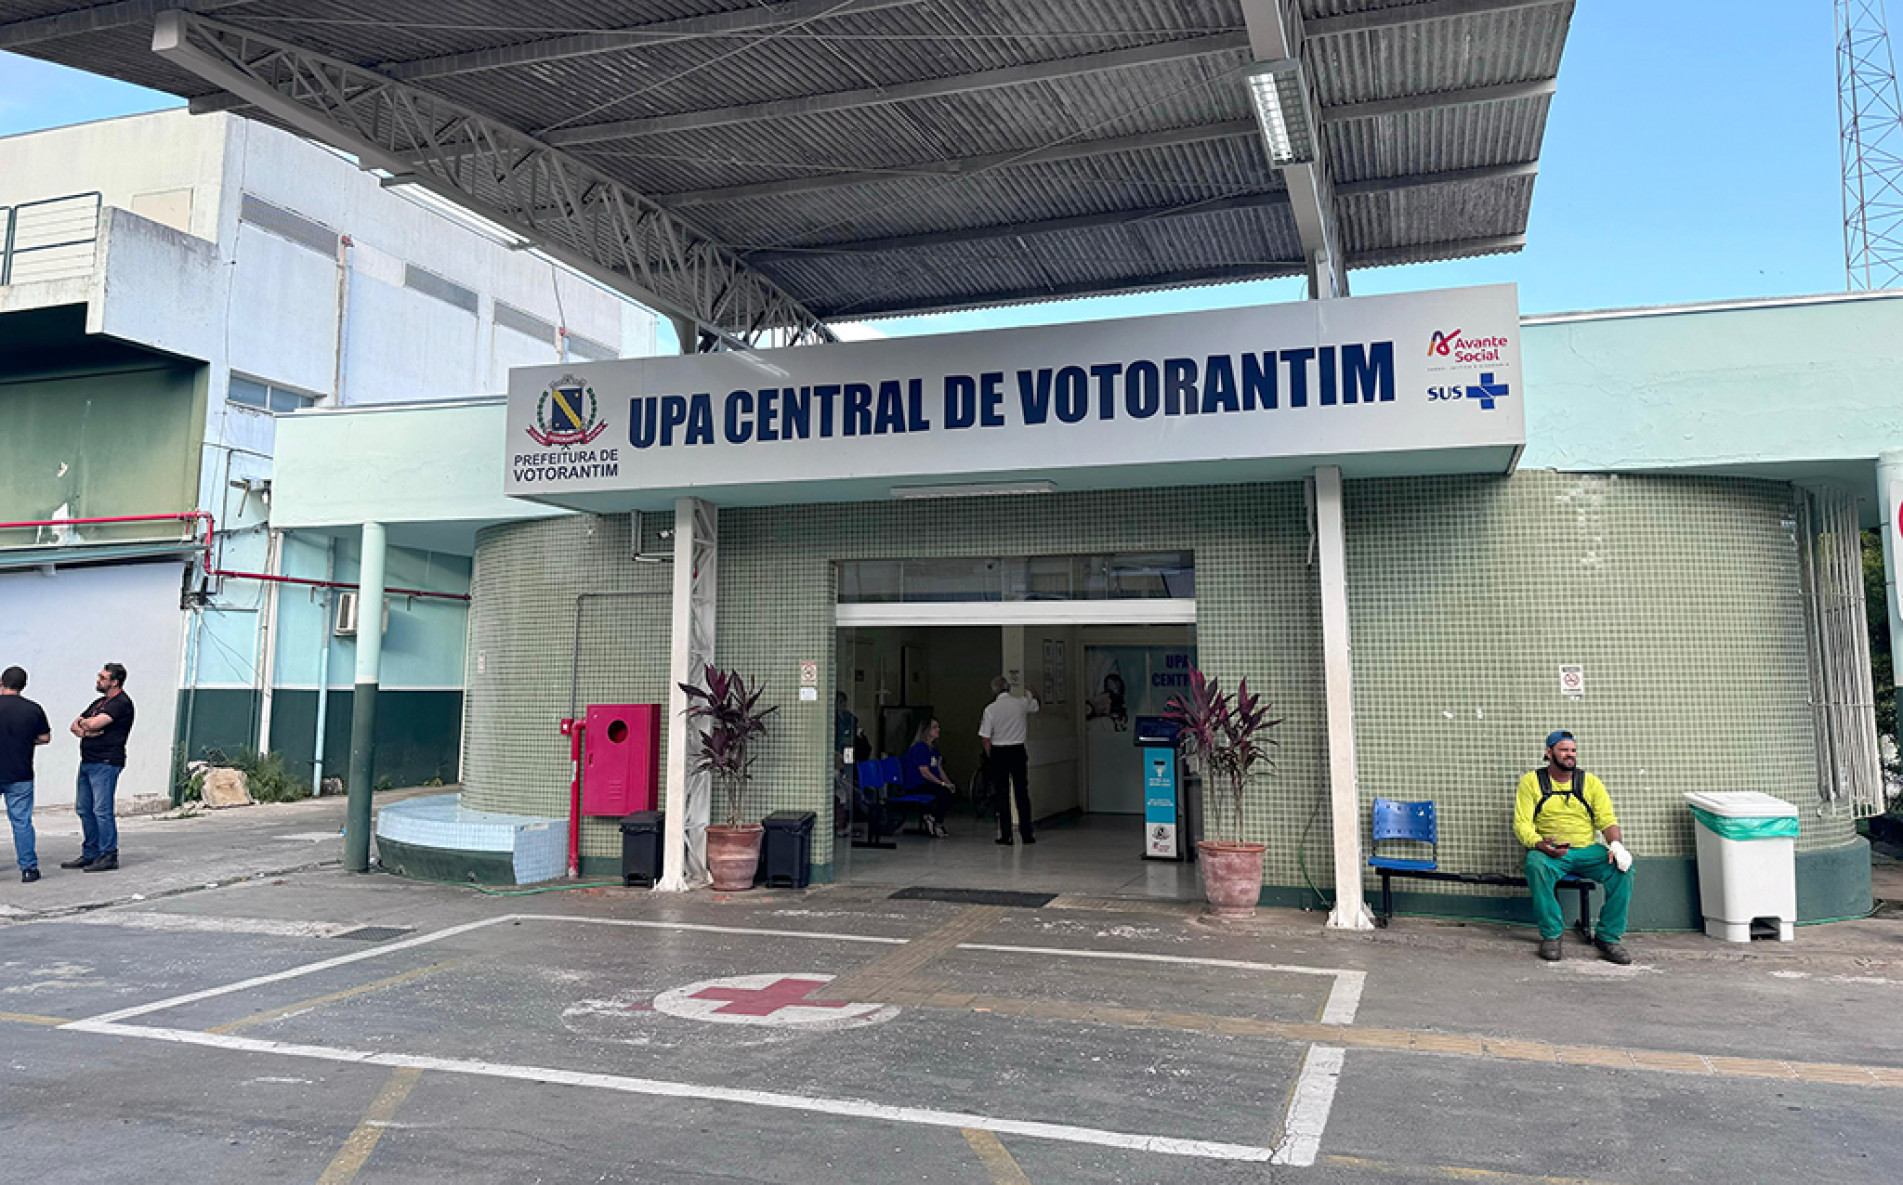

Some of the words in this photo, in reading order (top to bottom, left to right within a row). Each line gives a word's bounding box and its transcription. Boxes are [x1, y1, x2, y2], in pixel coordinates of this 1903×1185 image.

[1455, 336, 1507, 349] Avante
[1455, 349, 1499, 362] Social
[628, 393, 714, 449] UPA
[724, 378, 930, 443] CENTRAL
[943, 372, 1005, 429] DE
[1016, 341, 1395, 425] VOTORANTIM
[1427, 386, 1462, 400] SUS
[514, 450, 597, 466] PREFEITURA
[599, 449, 618, 462] DE
[513, 464, 618, 482] VOTORANTIM
